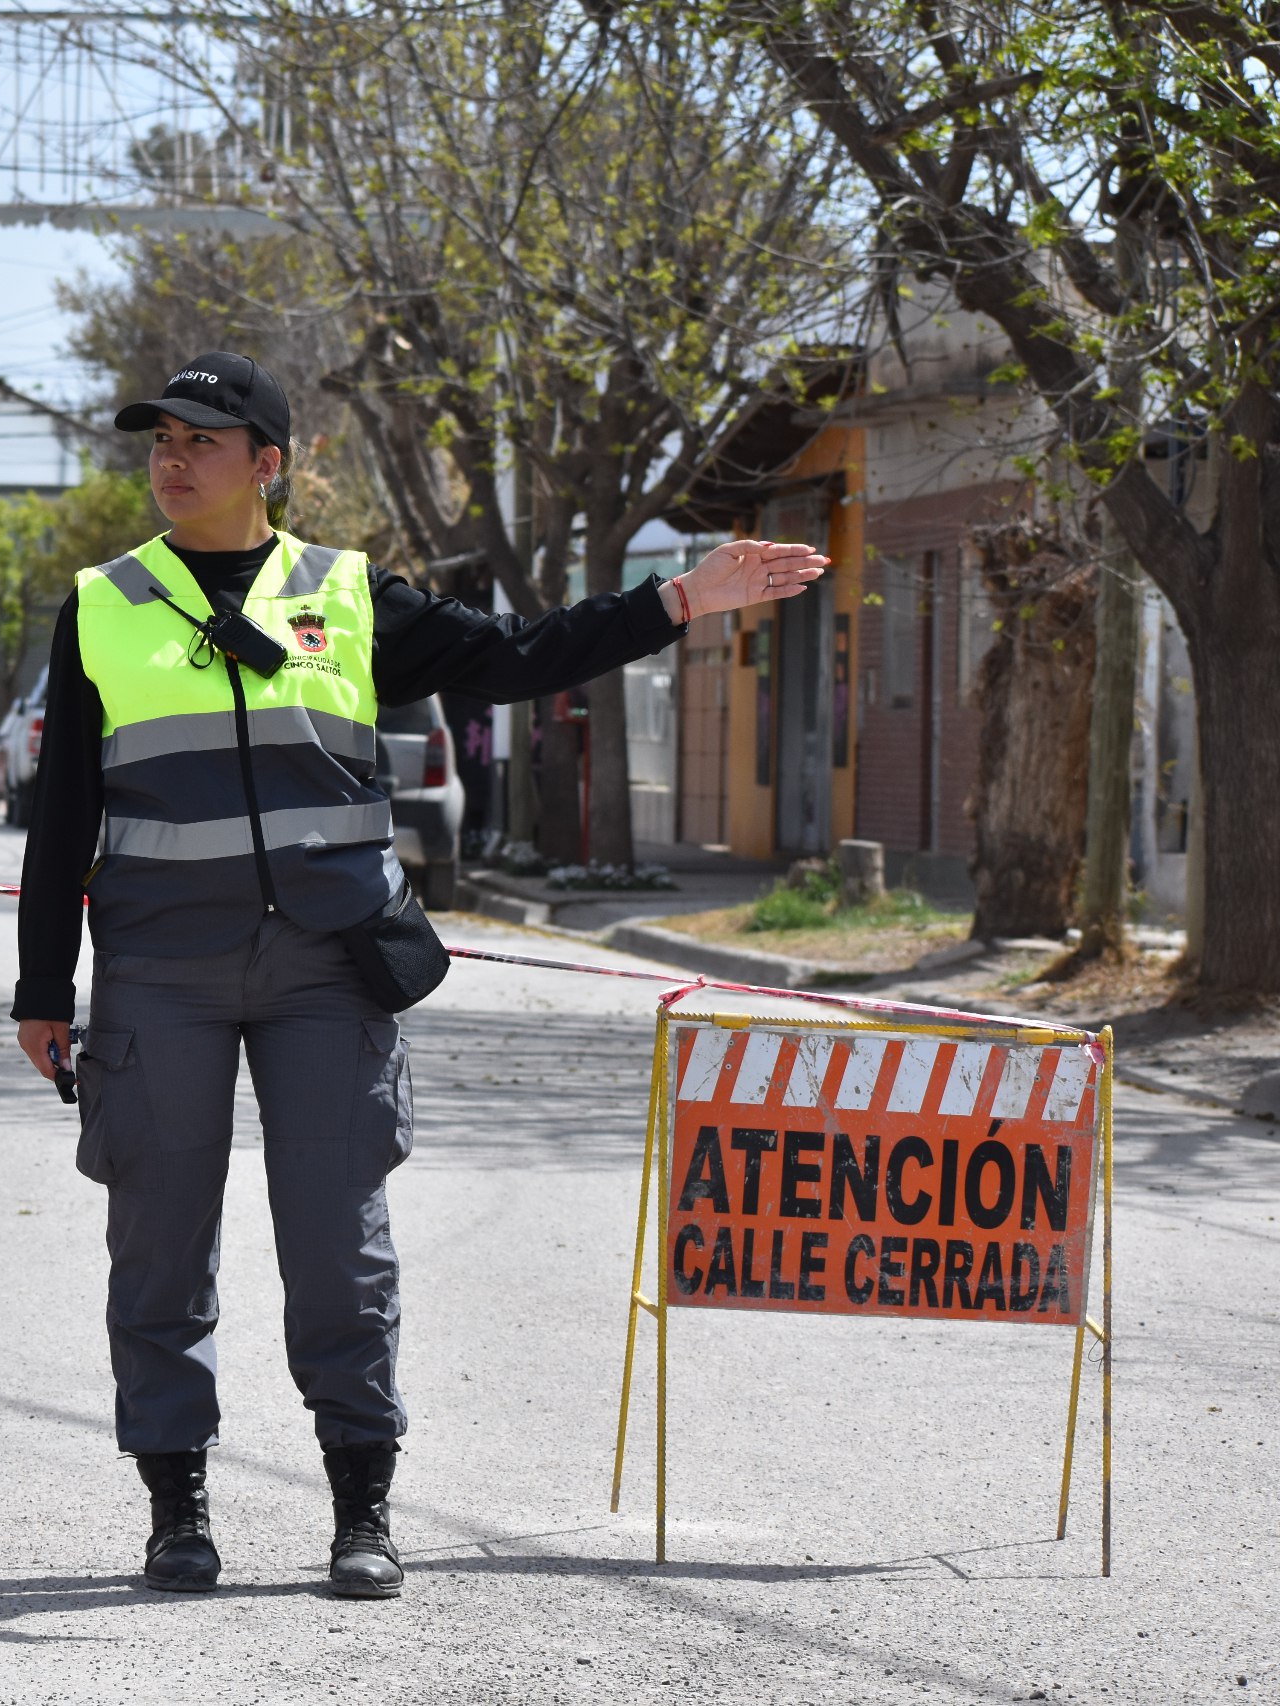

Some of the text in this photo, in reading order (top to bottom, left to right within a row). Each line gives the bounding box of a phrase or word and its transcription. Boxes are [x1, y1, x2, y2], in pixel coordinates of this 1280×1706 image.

[284, 661, 341, 676] CINCO SALTOS
[677, 1119, 1072, 1232] ATENCIÓN
[673, 1223, 1071, 1314] CALLE CERRADA
